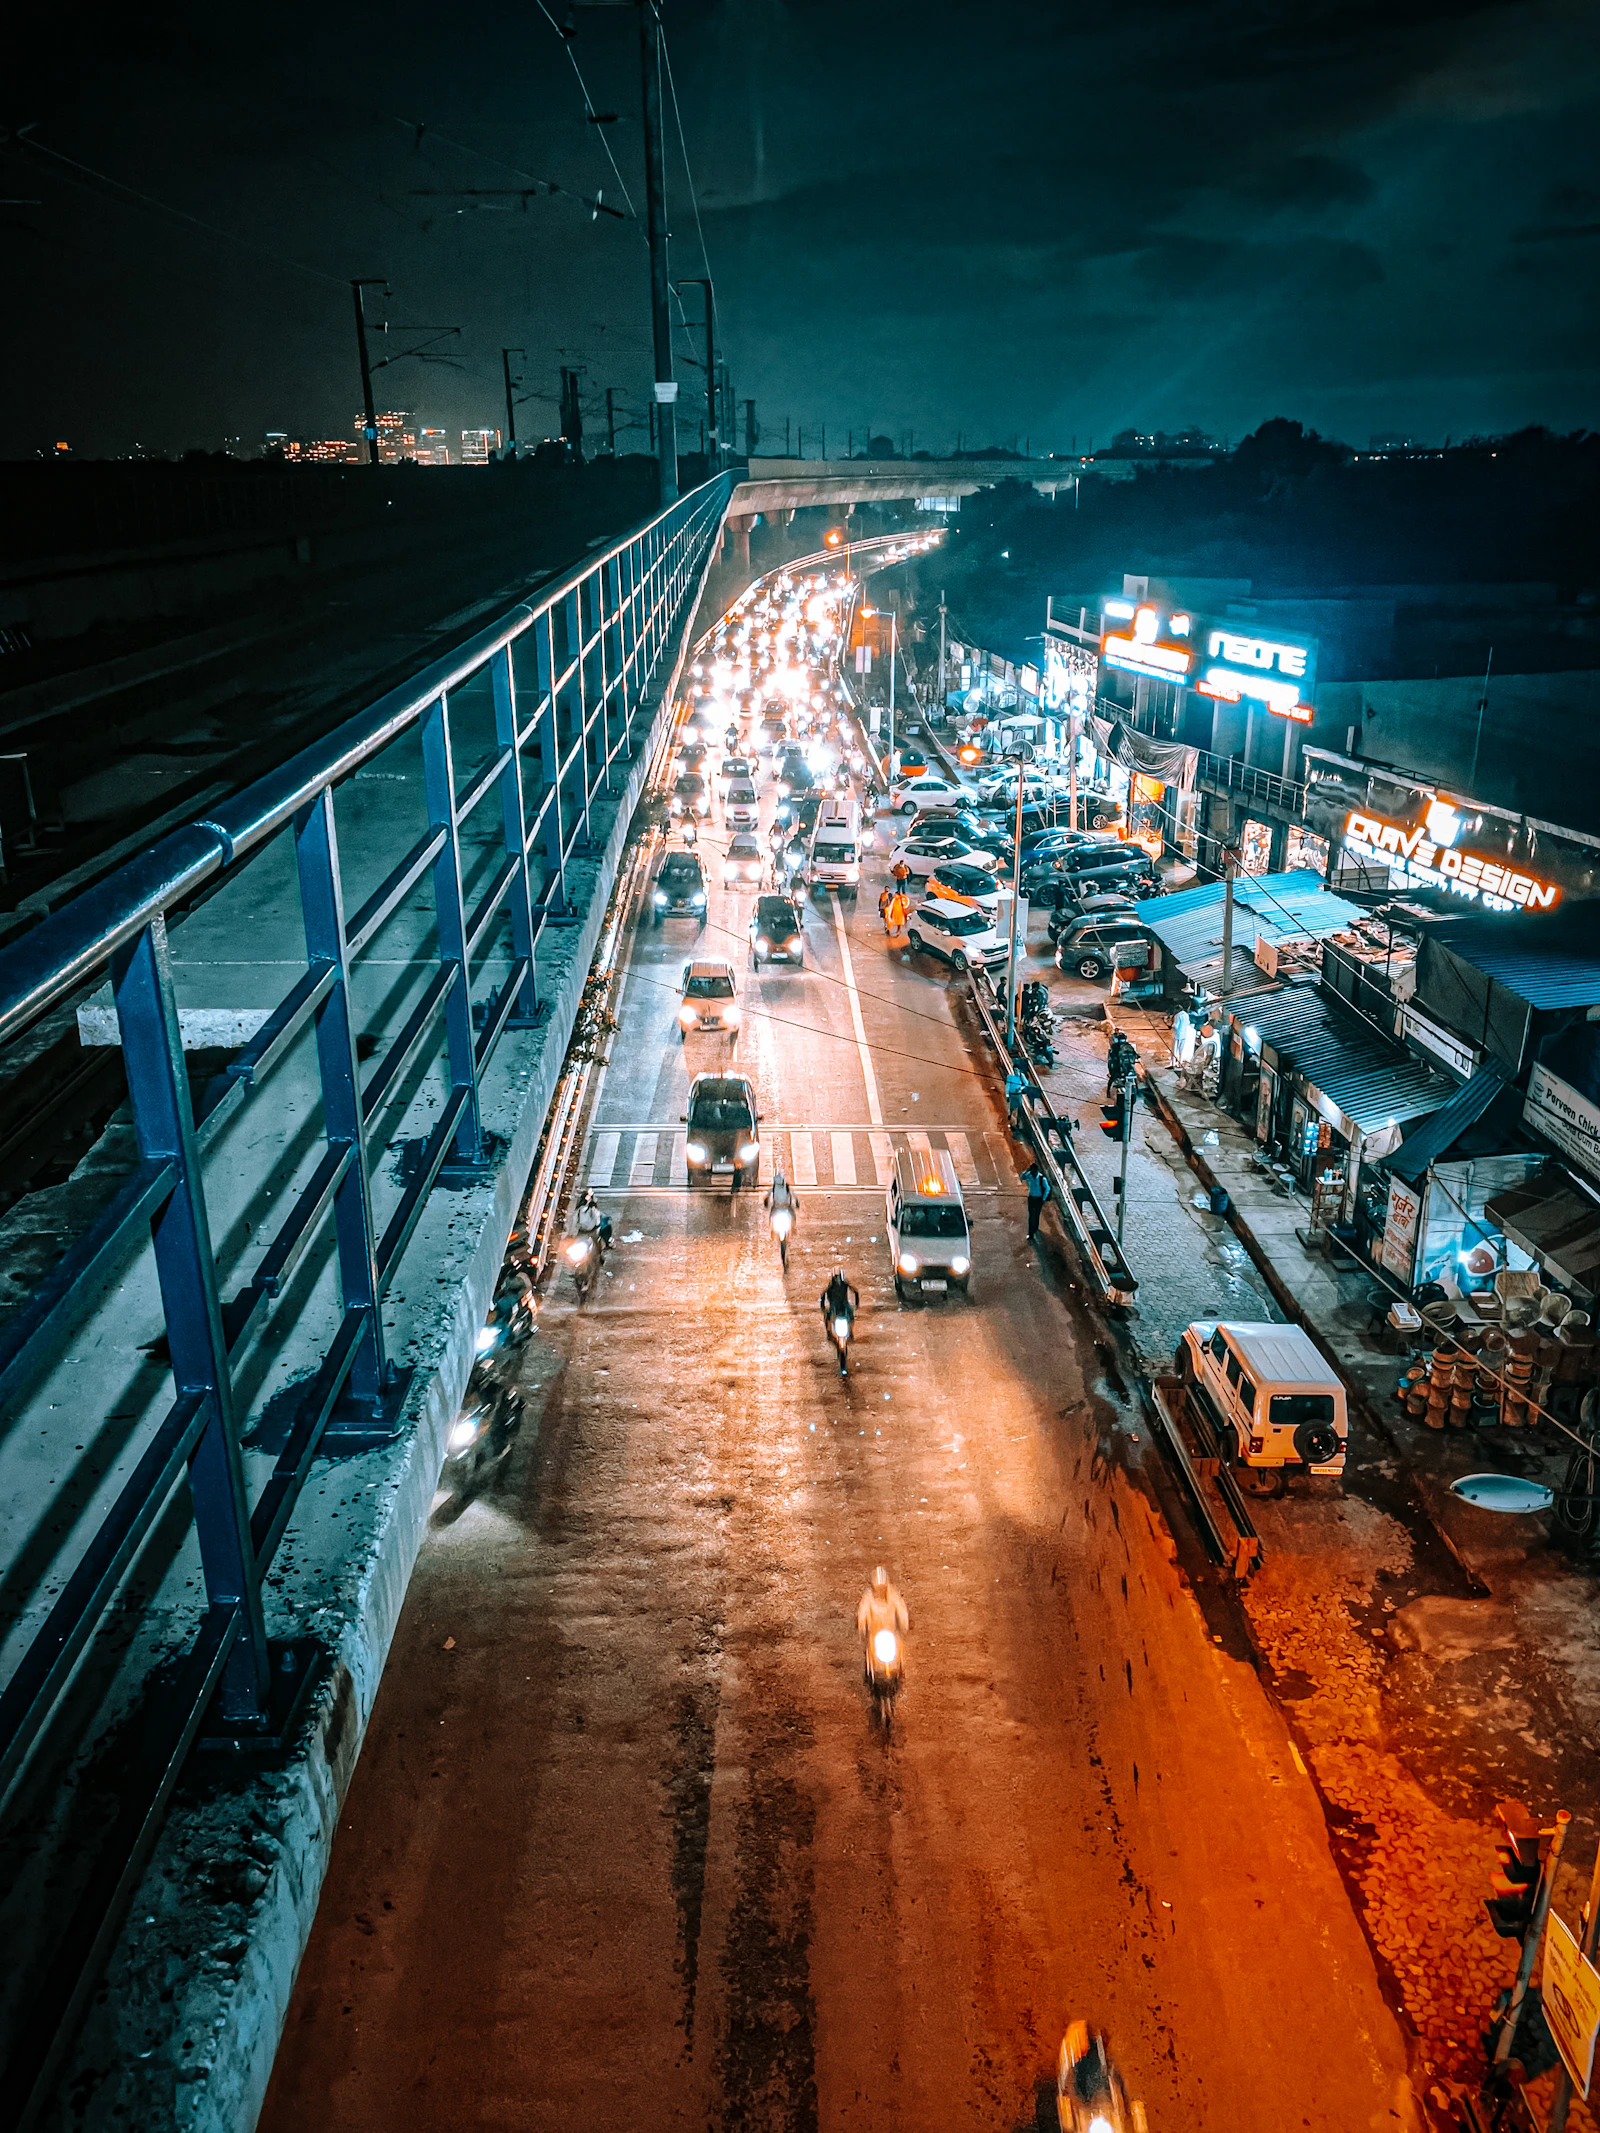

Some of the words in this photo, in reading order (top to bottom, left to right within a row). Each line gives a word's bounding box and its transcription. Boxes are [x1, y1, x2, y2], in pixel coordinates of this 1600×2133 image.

[1346, 812, 1437, 868] CRAVE
[1440, 849, 1556, 907] DESIGN
[1546, 1087, 1576, 1120] Parveen
